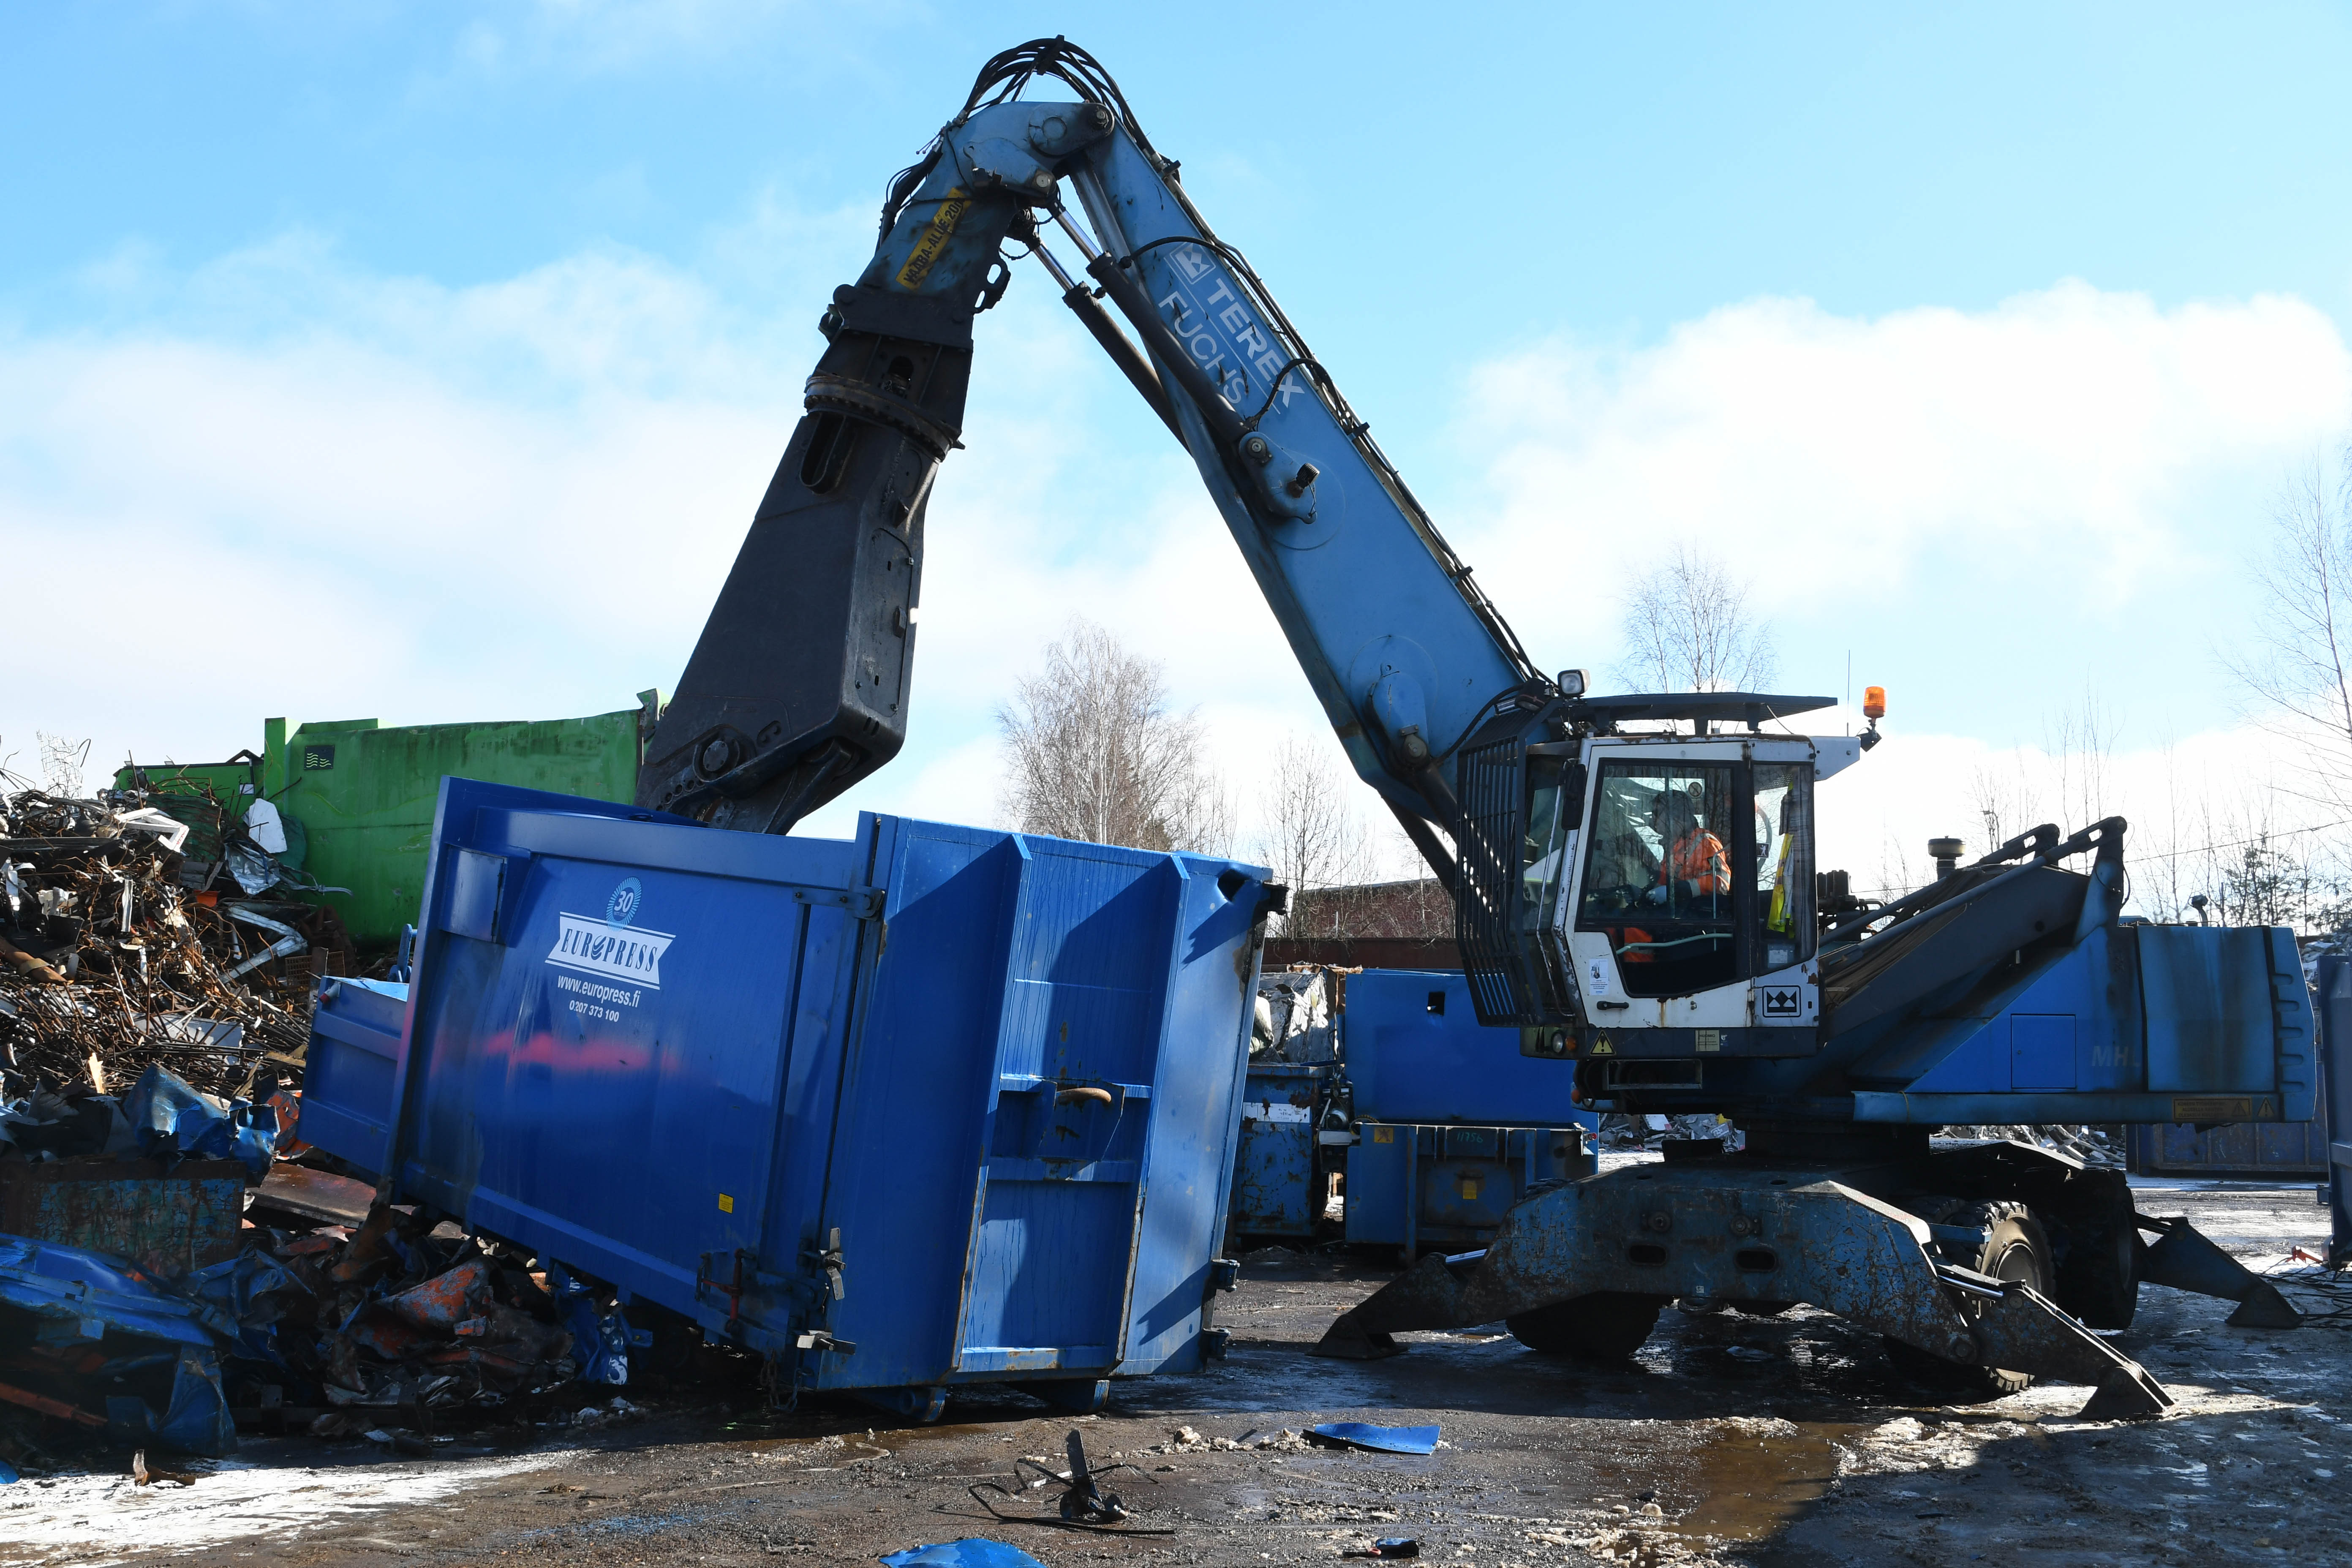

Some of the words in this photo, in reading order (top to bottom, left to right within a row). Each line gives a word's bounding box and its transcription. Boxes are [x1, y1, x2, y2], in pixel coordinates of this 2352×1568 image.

[1158, 291, 1246, 404] FUCHS
[1207, 278, 1304, 408] TEREX
[614, 891, 634, 913] 30
[561, 928, 658, 972] EUROPRESS
[558, 975, 641, 1007] www.europress.fi
[589, 1005, 603, 1018] 373
[605, 1009, 619, 1022] 100
